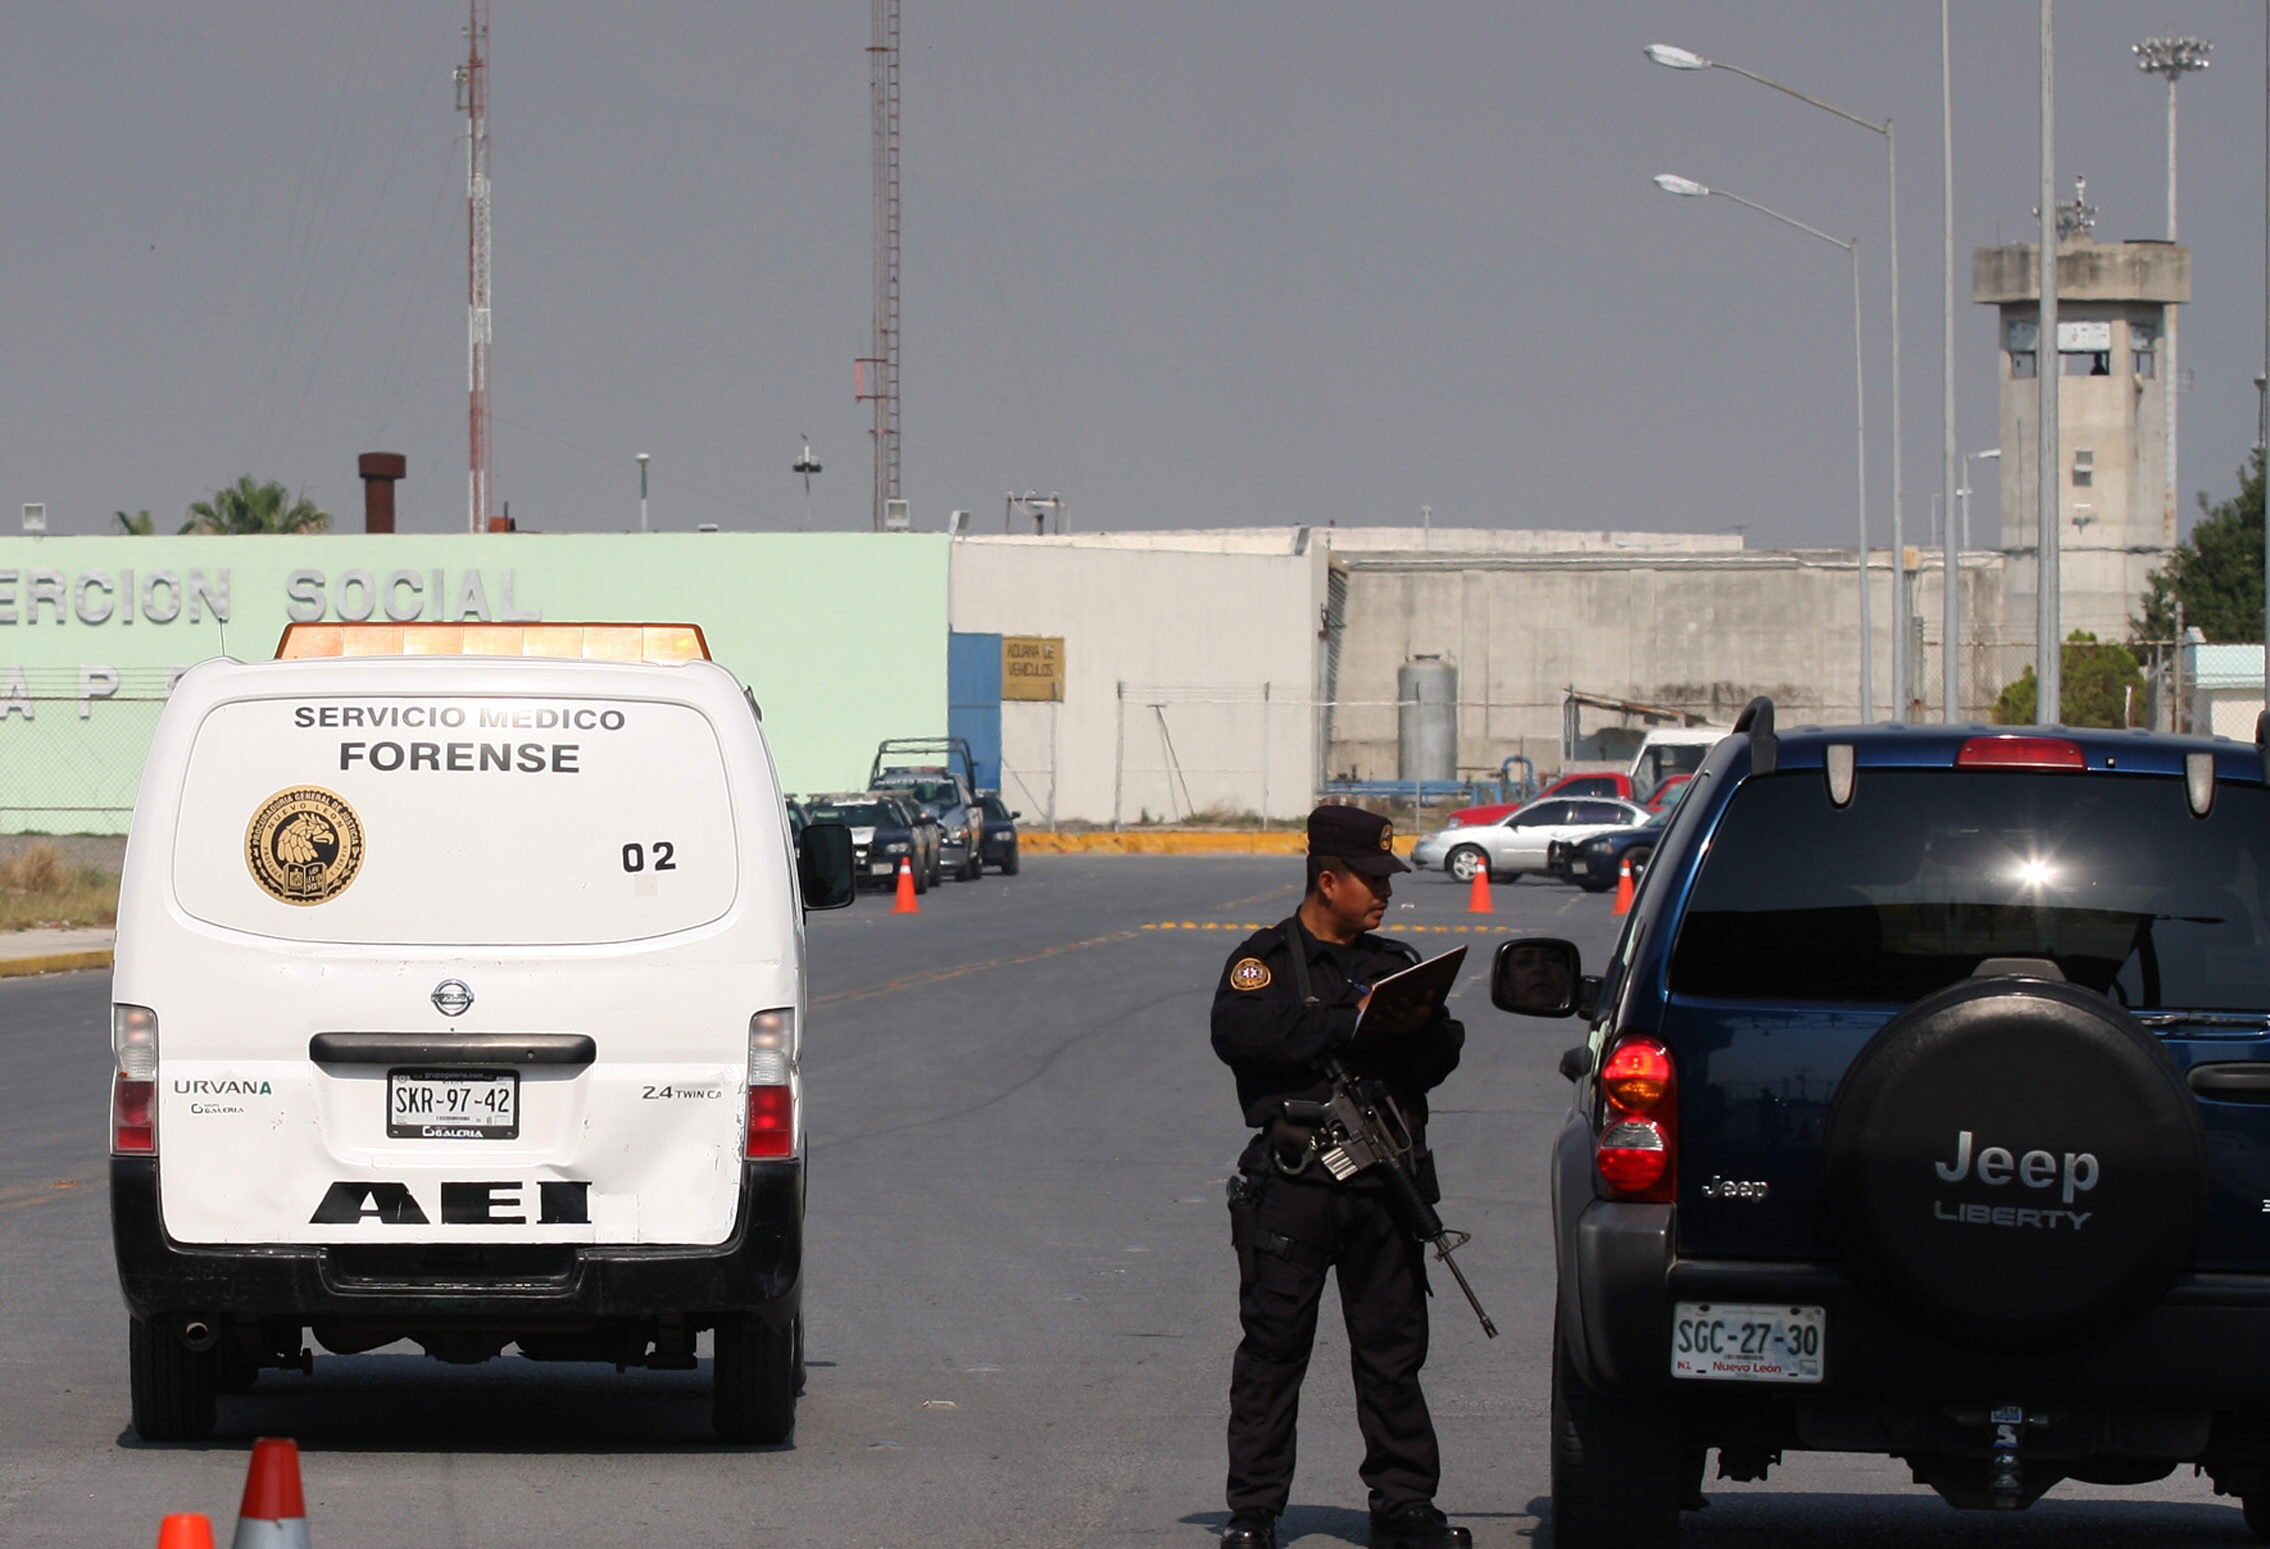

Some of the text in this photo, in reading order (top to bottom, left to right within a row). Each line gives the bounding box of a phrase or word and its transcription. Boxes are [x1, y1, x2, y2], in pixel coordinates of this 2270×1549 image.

[286, 568, 542, 623] SOCIAL
[294, 706, 625, 731] SERVICIO MEDICO
[340, 741, 580, 773] FORENSE
[267, 802, 344, 831] NUEVO LEON
[294, 792, 330, 805] GENERAL
[331, 801, 343, 813] DE
[340, 809, 360, 846] JUSTICIA
[395, 1086, 510, 1114] SKR-97-42
[675, 1090, 705, 1099] TWIN
[1935, 1130, 2100, 1204] Jeep
[308, 1180, 593, 1225] AEI
[1701, 1174, 1769, 1203] Jeep
[1933, 1200, 2093, 1230] LIBERTY
[1677, 1318, 1818, 1356] SGC-27-30
[1712, 1360, 1750, 1373] Nuevo
[1753, 1362, 1782, 1374] León
